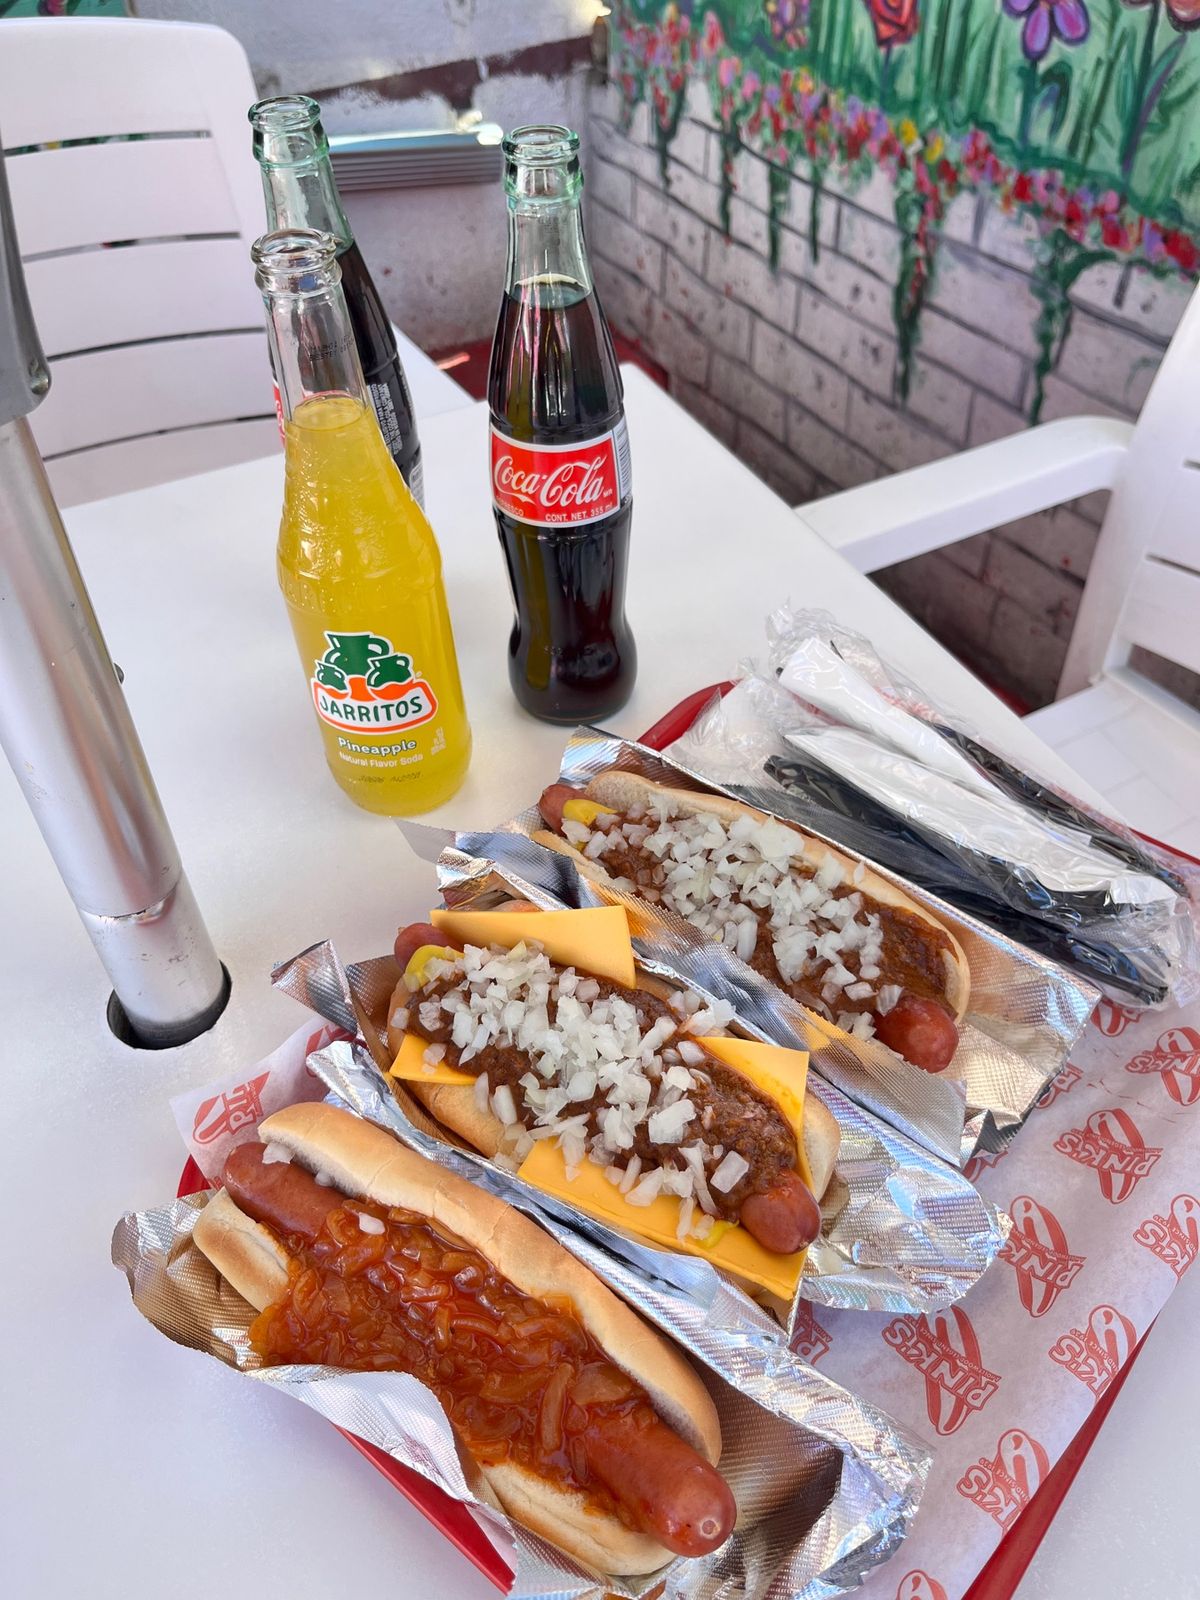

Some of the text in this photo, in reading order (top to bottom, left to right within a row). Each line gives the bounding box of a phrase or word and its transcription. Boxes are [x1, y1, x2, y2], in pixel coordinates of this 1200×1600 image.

[494, 454, 607, 507] Coca-Cola
[545, 513, 568, 522] CONT.
[571, 511, 588, 521] NET.
[591, 507, 604, 517] 355
[320, 695, 423, 722] JARRITOS
[338, 736, 417, 757] Pineapple
[339, 751, 424, 768] Natural Flavor Soda
[1052, 1130, 1160, 1178] PINK'S
[996, 1237, 1082, 1287] PINK
[880, 1316, 998, 1410] PINK'S
